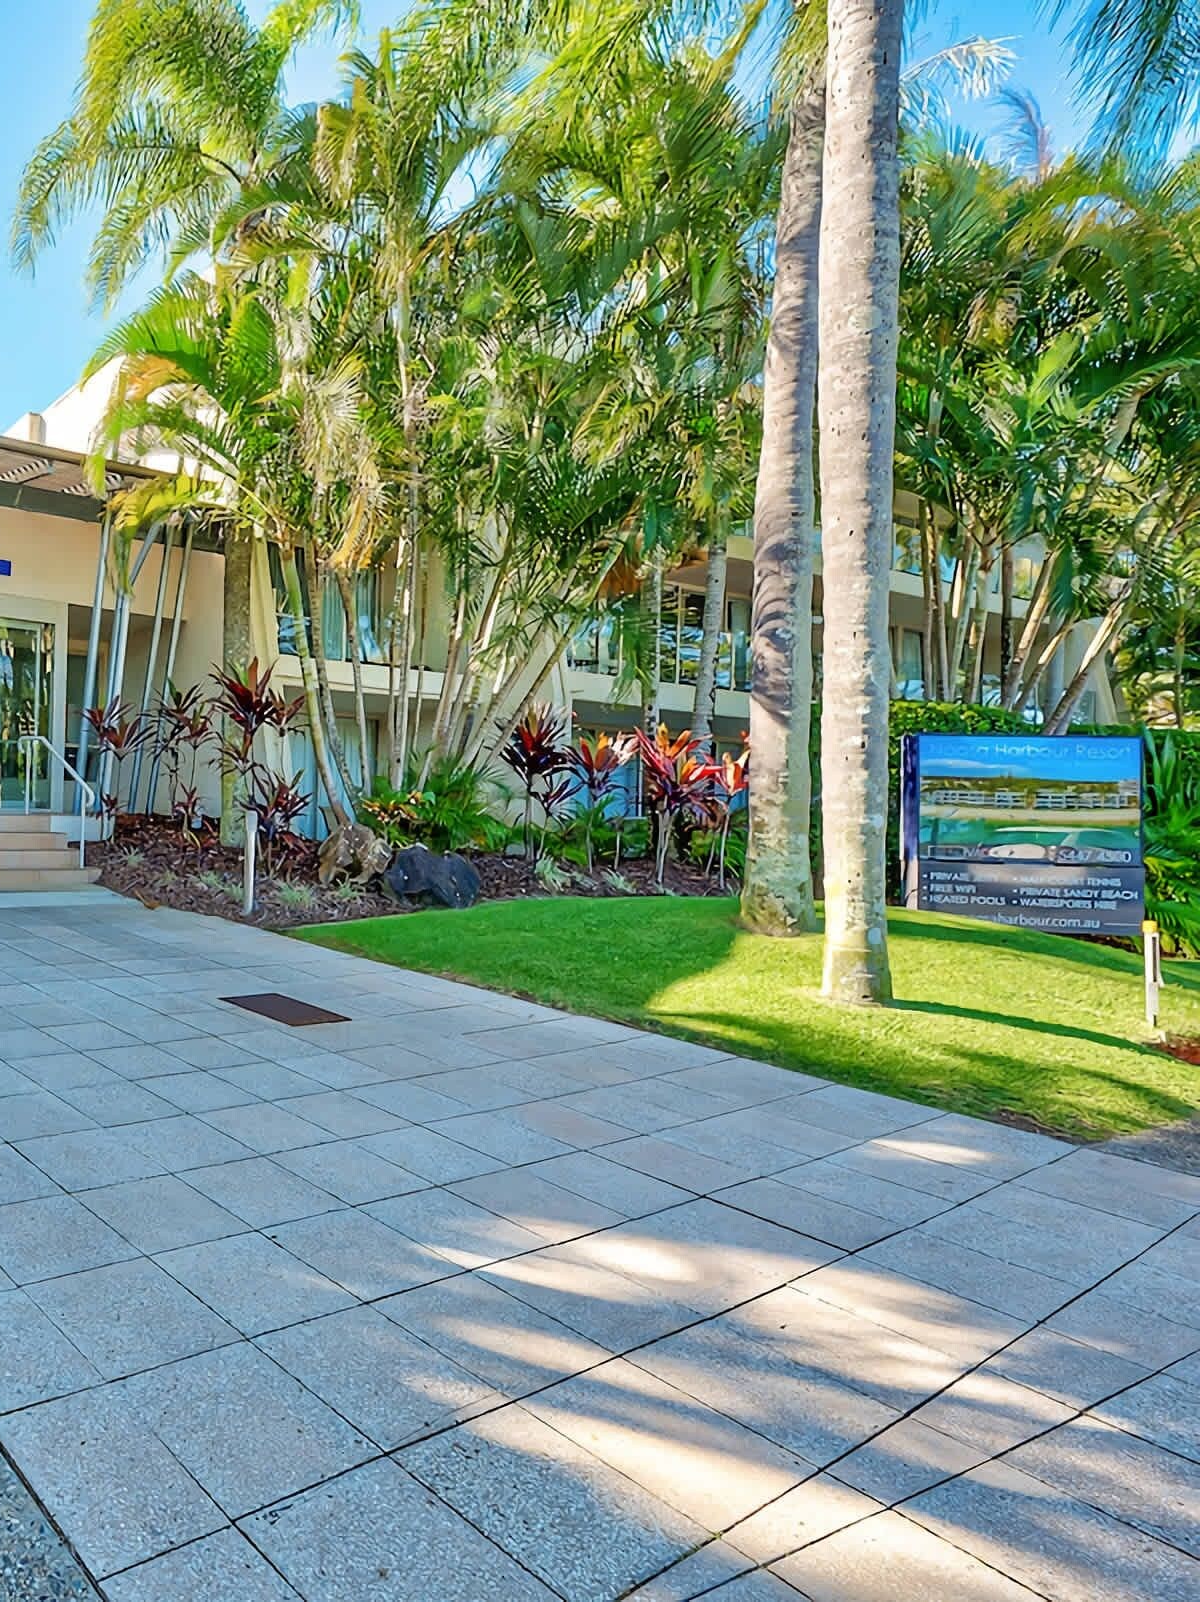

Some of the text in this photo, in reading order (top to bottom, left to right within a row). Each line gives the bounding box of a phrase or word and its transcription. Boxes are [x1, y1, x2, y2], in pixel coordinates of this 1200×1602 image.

[995, 743, 1070, 758] Harbour
[1075, 745, 1132, 760] Resort
[1019, 888, 1139, 900] PRIVATE SANDY BEACH
[930, 895, 1006, 907] HEATED POOLS
